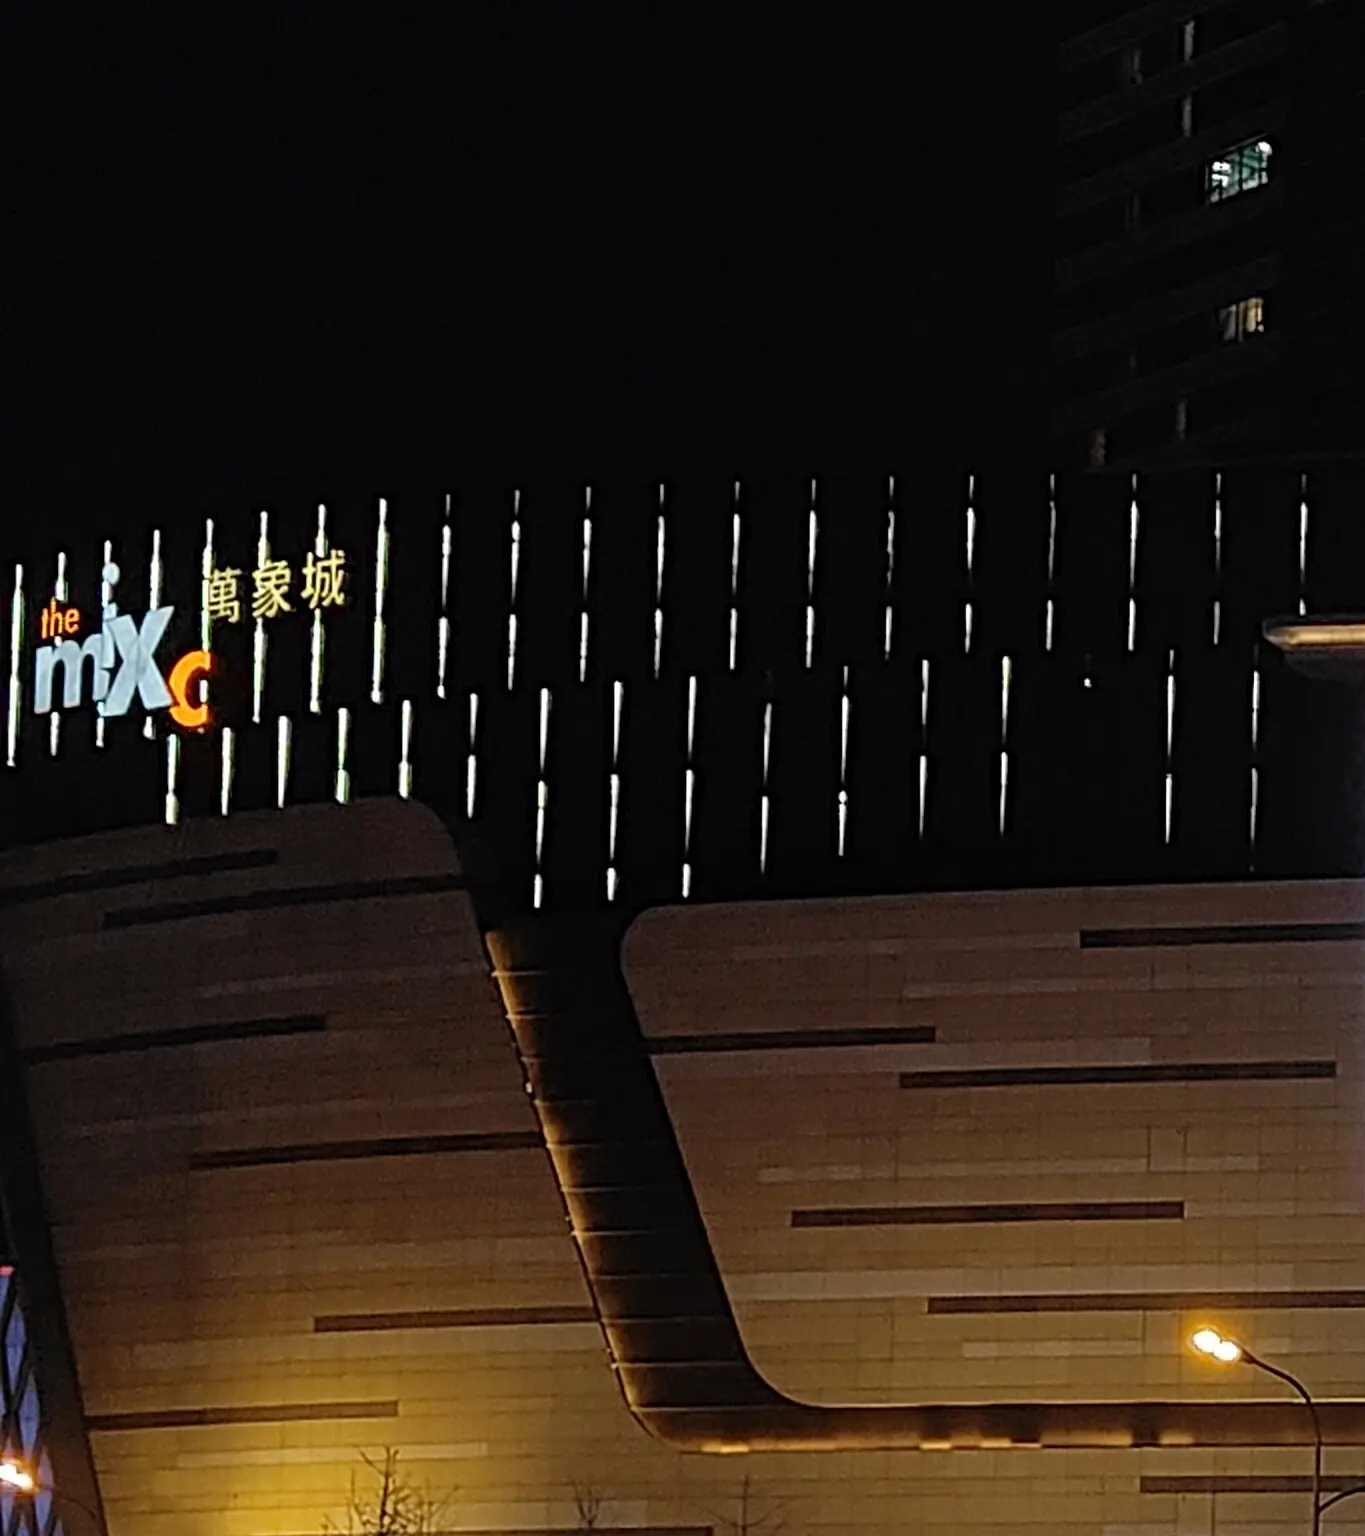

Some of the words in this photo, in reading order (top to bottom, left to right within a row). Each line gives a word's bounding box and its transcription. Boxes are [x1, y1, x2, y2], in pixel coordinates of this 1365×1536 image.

[205, 549, 348, 625] 萬象城
[40, 596, 80, 640] the
